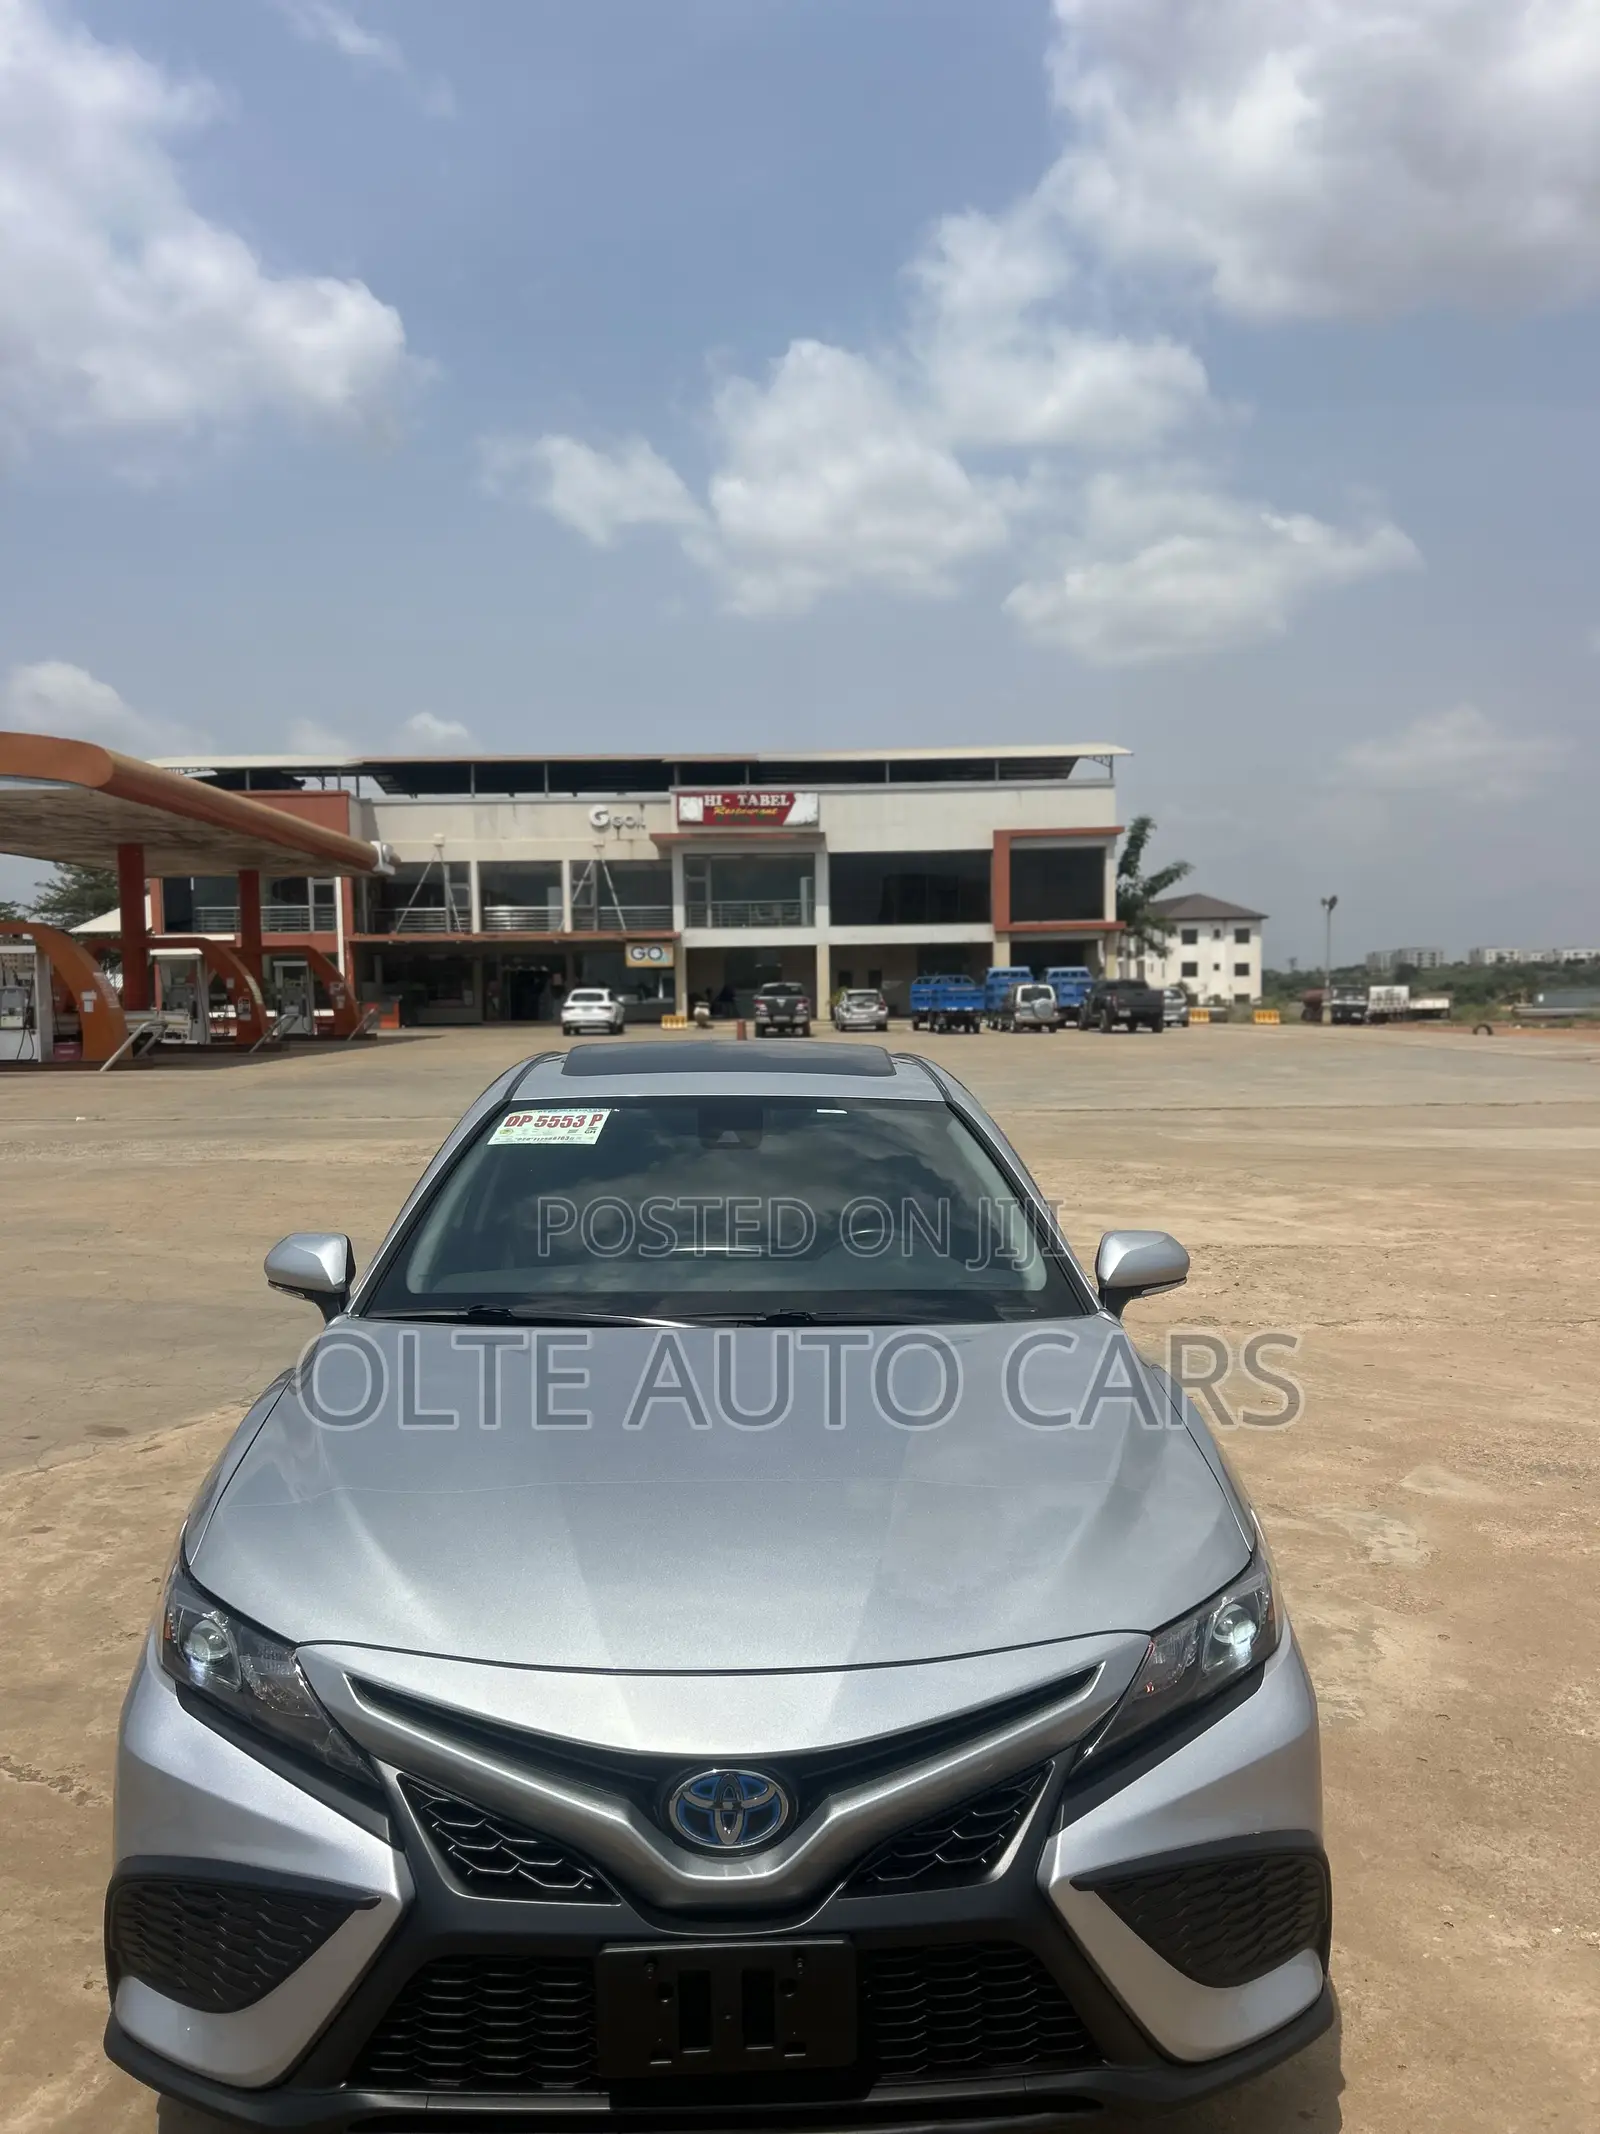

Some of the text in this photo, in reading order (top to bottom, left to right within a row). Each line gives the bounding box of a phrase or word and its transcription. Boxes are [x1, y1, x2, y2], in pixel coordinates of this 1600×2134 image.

[737, 795, 790, 806] TABEL
[631, 946, 663, 961] GO
[534, 1115, 587, 1128] 5553
[588, 1113, 604, 1127] P
